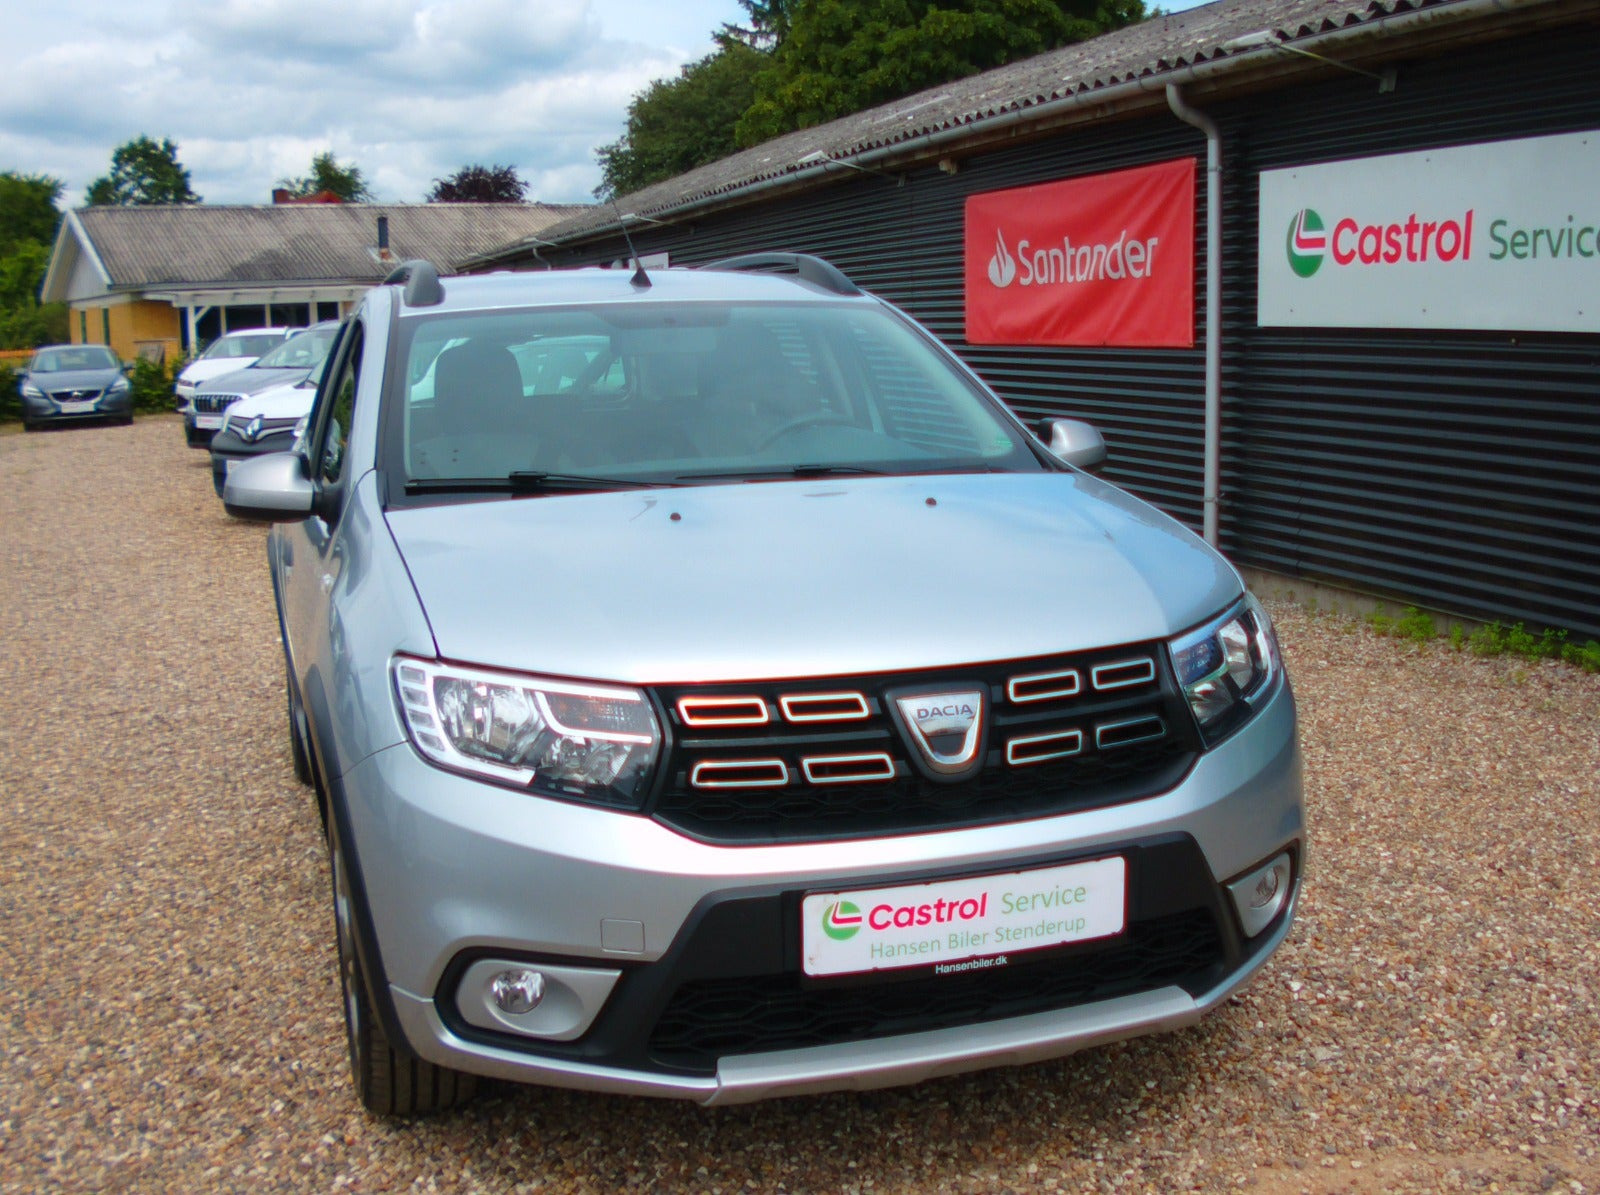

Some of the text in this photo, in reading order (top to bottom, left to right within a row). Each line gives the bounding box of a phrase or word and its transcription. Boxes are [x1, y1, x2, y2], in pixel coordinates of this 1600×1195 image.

[1018, 229, 1158, 286] Santander
[1332, 208, 1600, 266] Castrol Servic
[917, 704, 973, 719] DACIA
[868, 885, 1086, 931] Castrol Service
[870, 916, 1086, 959] Hansen Biler Stenderup
[935, 955, 1008, 975] Hansenbiler.dk
